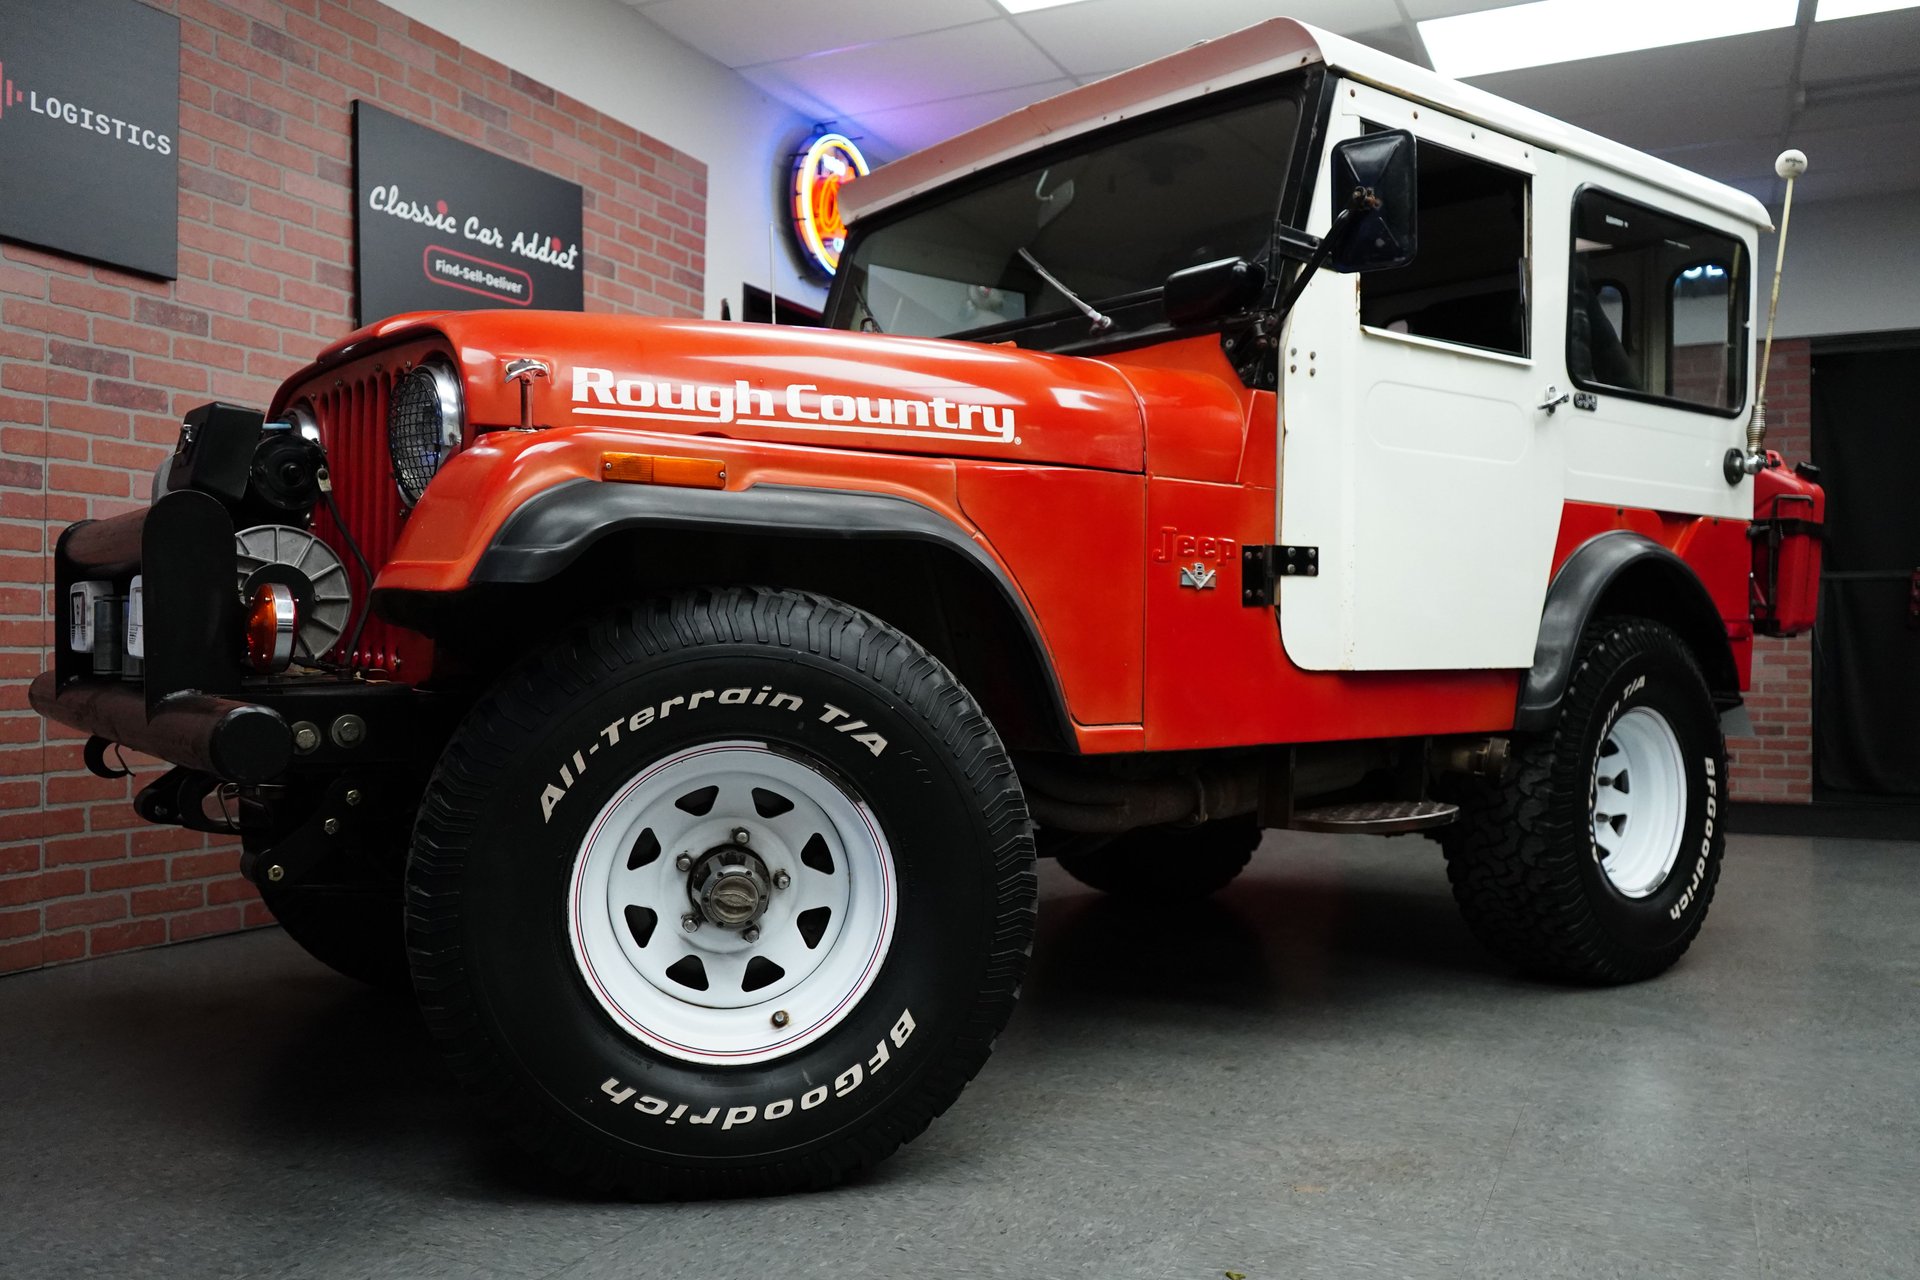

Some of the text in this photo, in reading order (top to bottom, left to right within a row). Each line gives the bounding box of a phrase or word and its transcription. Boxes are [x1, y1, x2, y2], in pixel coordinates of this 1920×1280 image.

[30, 91, 171, 155] LOGISTICS
[369, 184, 578, 271] Classic Car Addict
[435, 259, 523, 294] Find-Sell-Deliver
[571, 366, 1015, 444] Rough Country
[1152, 526, 1238, 567] Jeep
[1623, 675, 1646, 700] T/A
[540, 685, 888, 824] All-Terrain T/A
[1670, 756, 1717, 920] BFGoodrich
[600, 1007, 917, 1130] BFGoodrich
